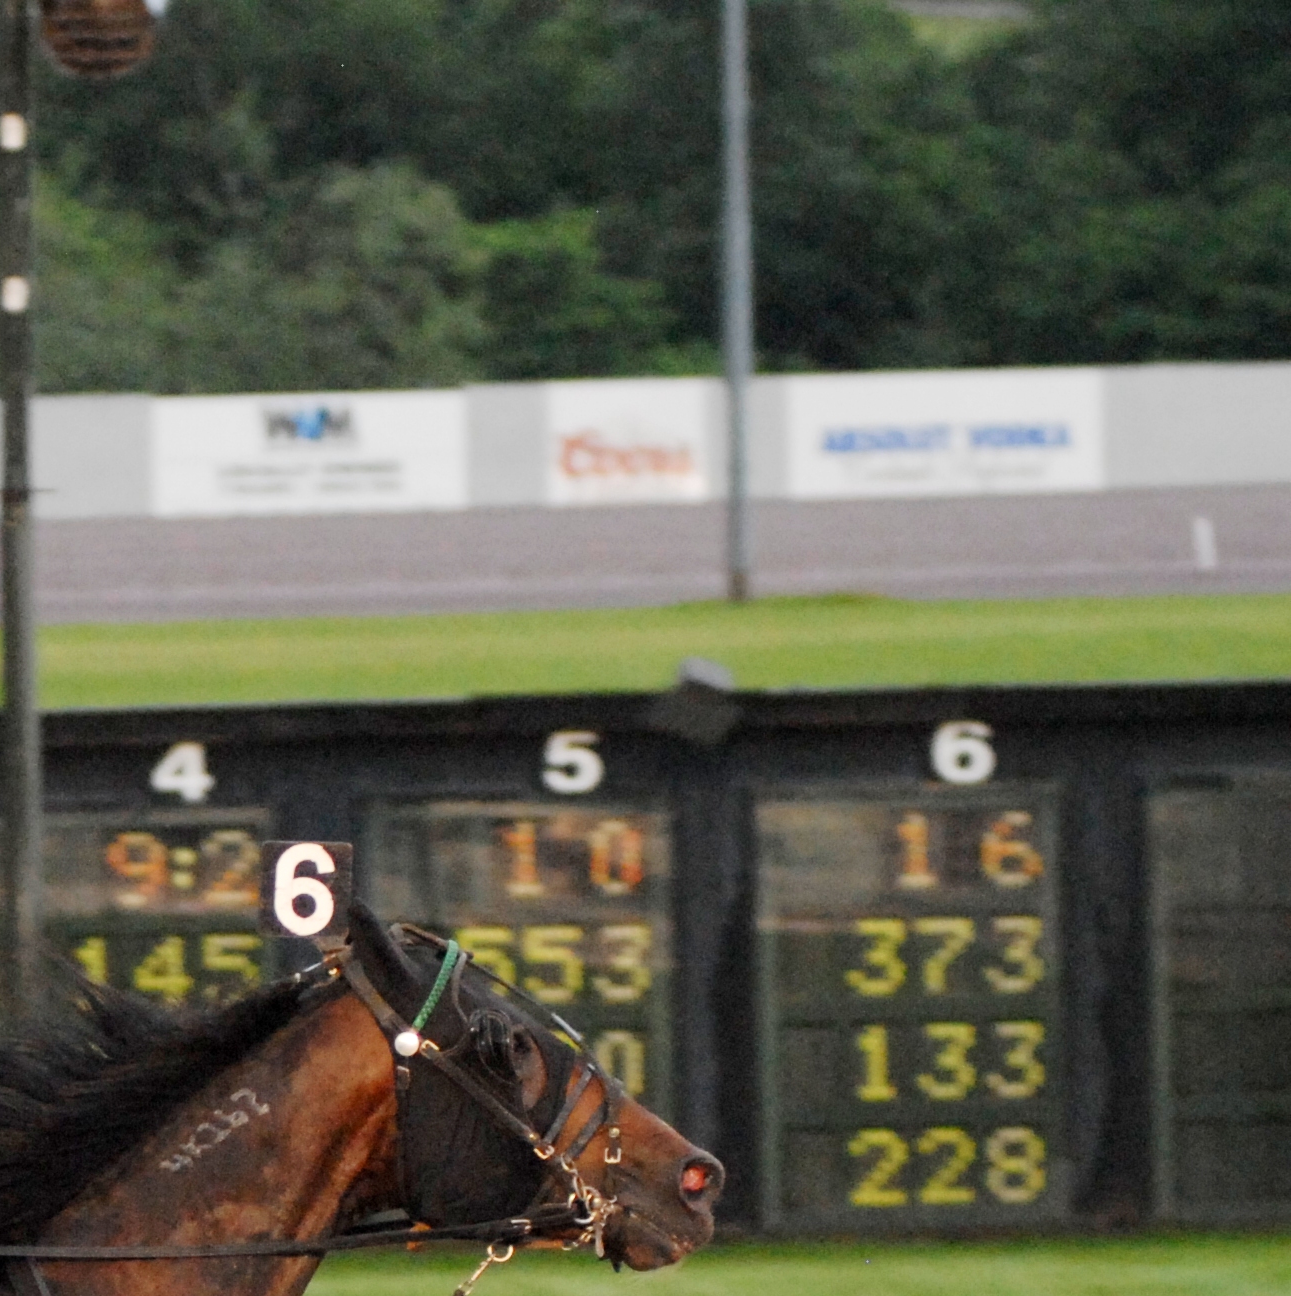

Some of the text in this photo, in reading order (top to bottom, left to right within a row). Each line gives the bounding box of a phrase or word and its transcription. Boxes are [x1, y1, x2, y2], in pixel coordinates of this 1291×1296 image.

[150, 741, 215, 801] 4
[542, 731, 606, 794] 5
[930, 720, 996, 785] 6
[273, 842, 336, 937] 6
[845, 915, 1045, 995] 373
[856, 1021, 1046, 1101] 133
[848, 1126, 1047, 1206] 228
